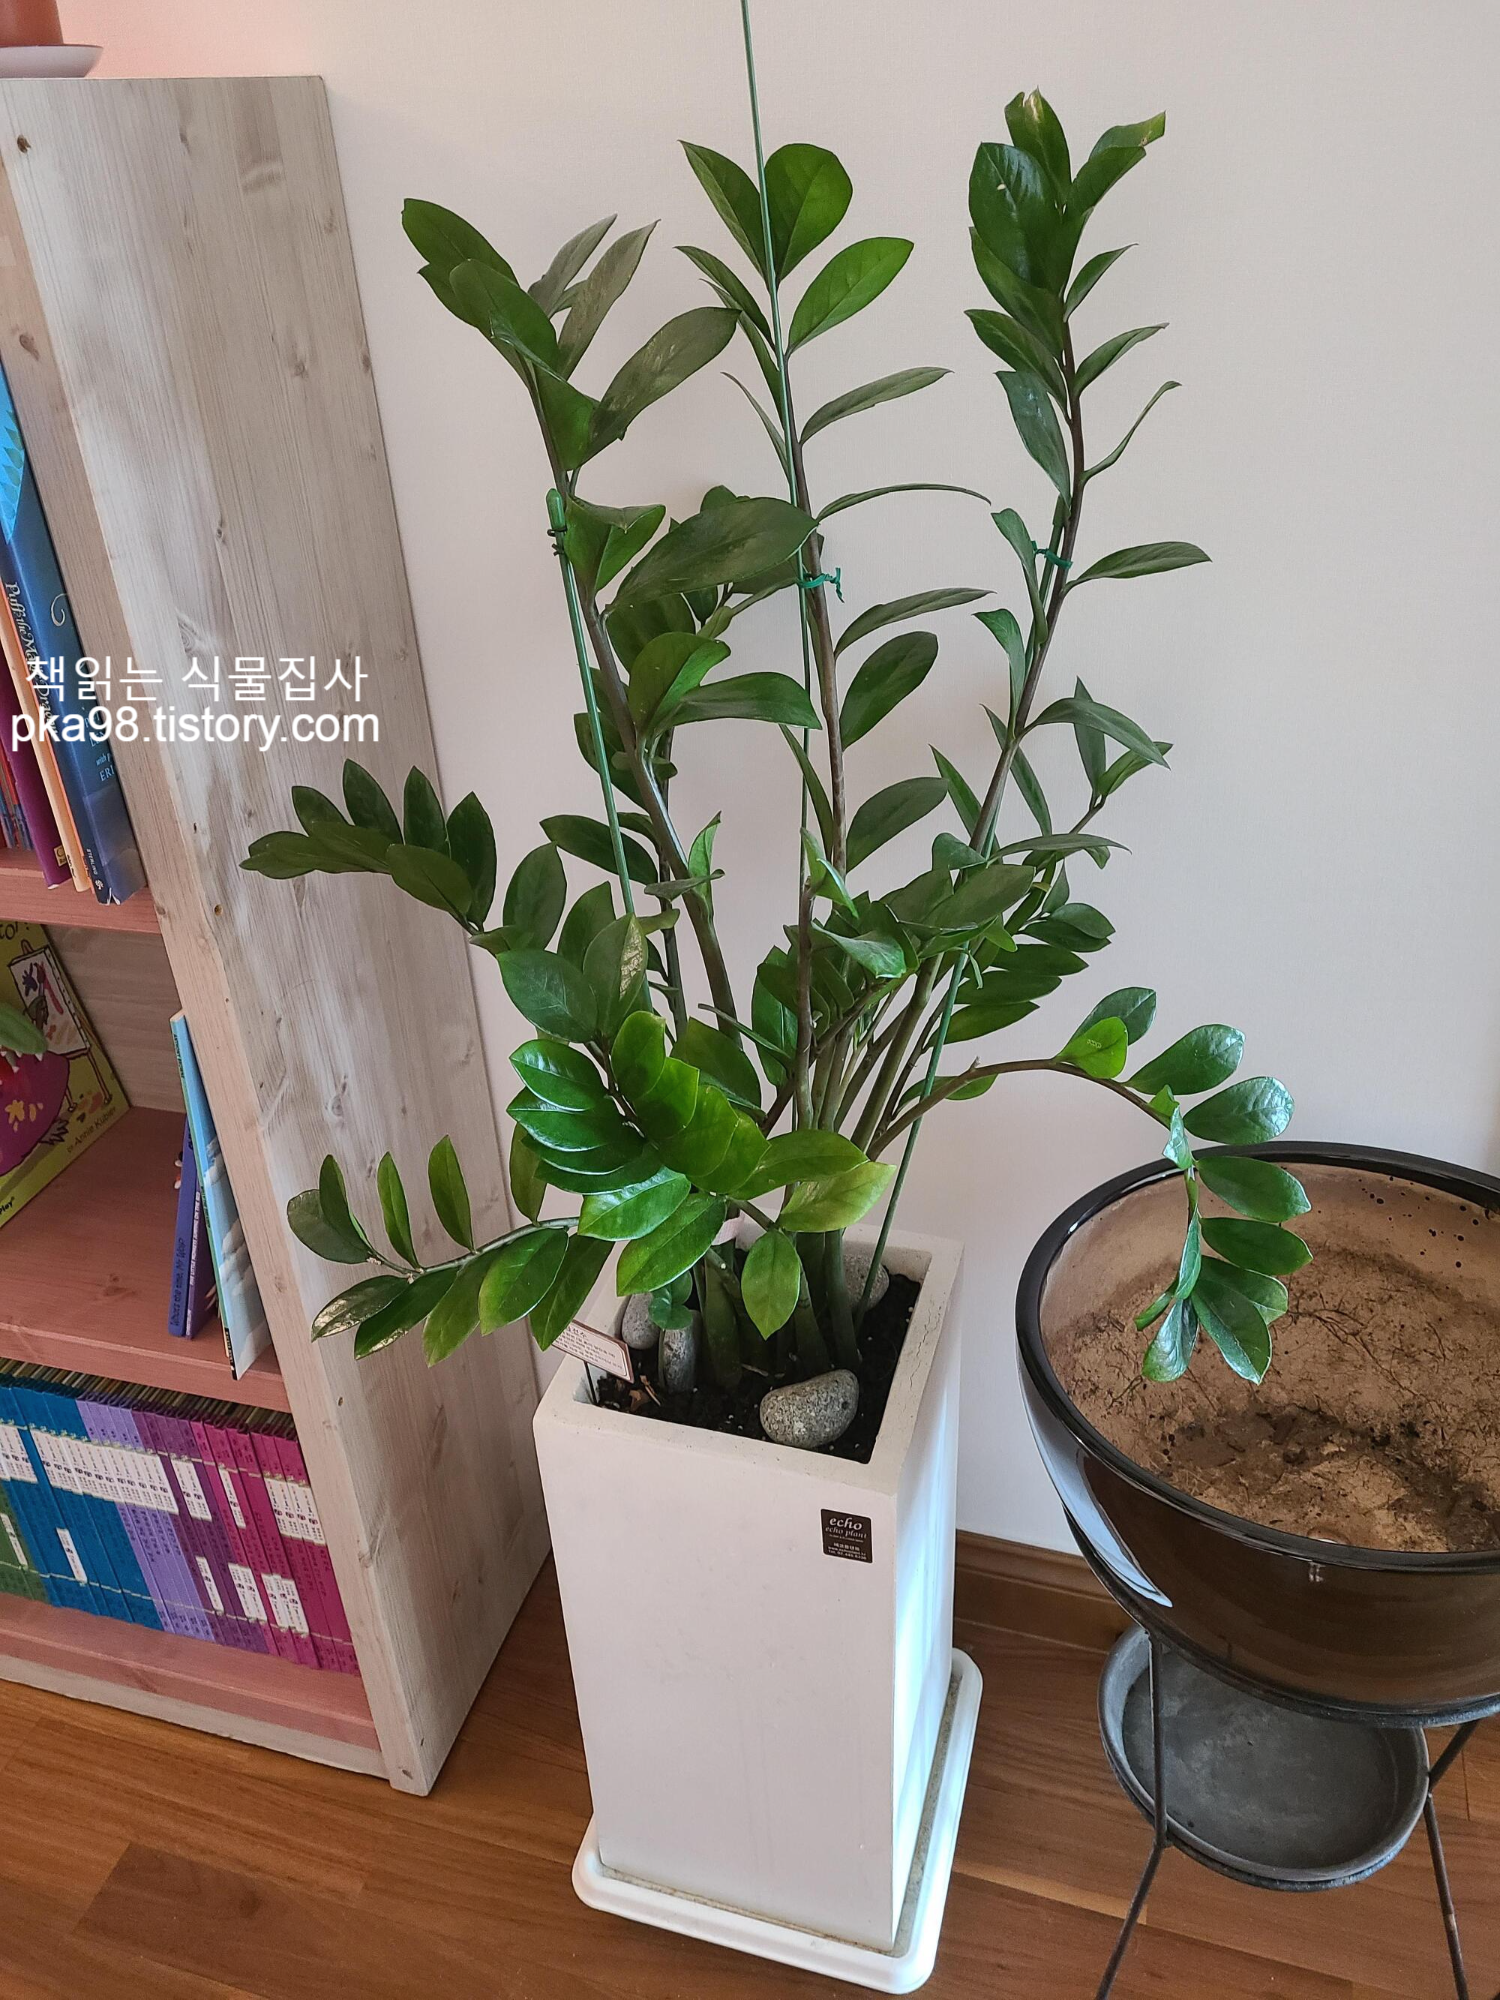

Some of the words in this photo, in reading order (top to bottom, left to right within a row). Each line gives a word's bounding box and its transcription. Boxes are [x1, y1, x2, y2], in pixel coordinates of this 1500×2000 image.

[829, 1517, 863, 1530] echo
[825, 1527, 844, 1535] echo
[845, 1530, 867, 1539] plant
